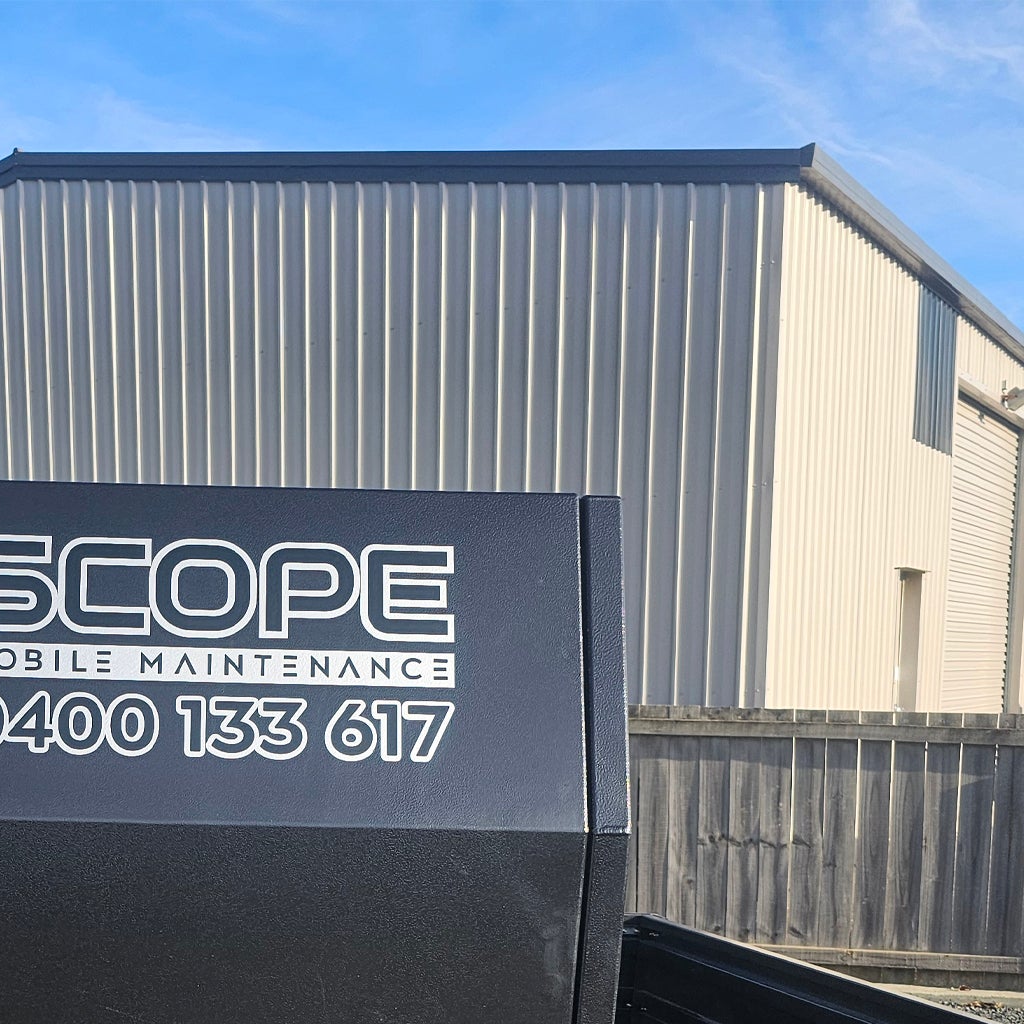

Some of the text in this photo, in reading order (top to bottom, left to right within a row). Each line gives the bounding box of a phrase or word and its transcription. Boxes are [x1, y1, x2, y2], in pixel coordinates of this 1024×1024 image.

[139, 650, 449, 681] MAINTENANCE
[175, 694, 308, 761] 133
[324, 699, 456, 763] 617
